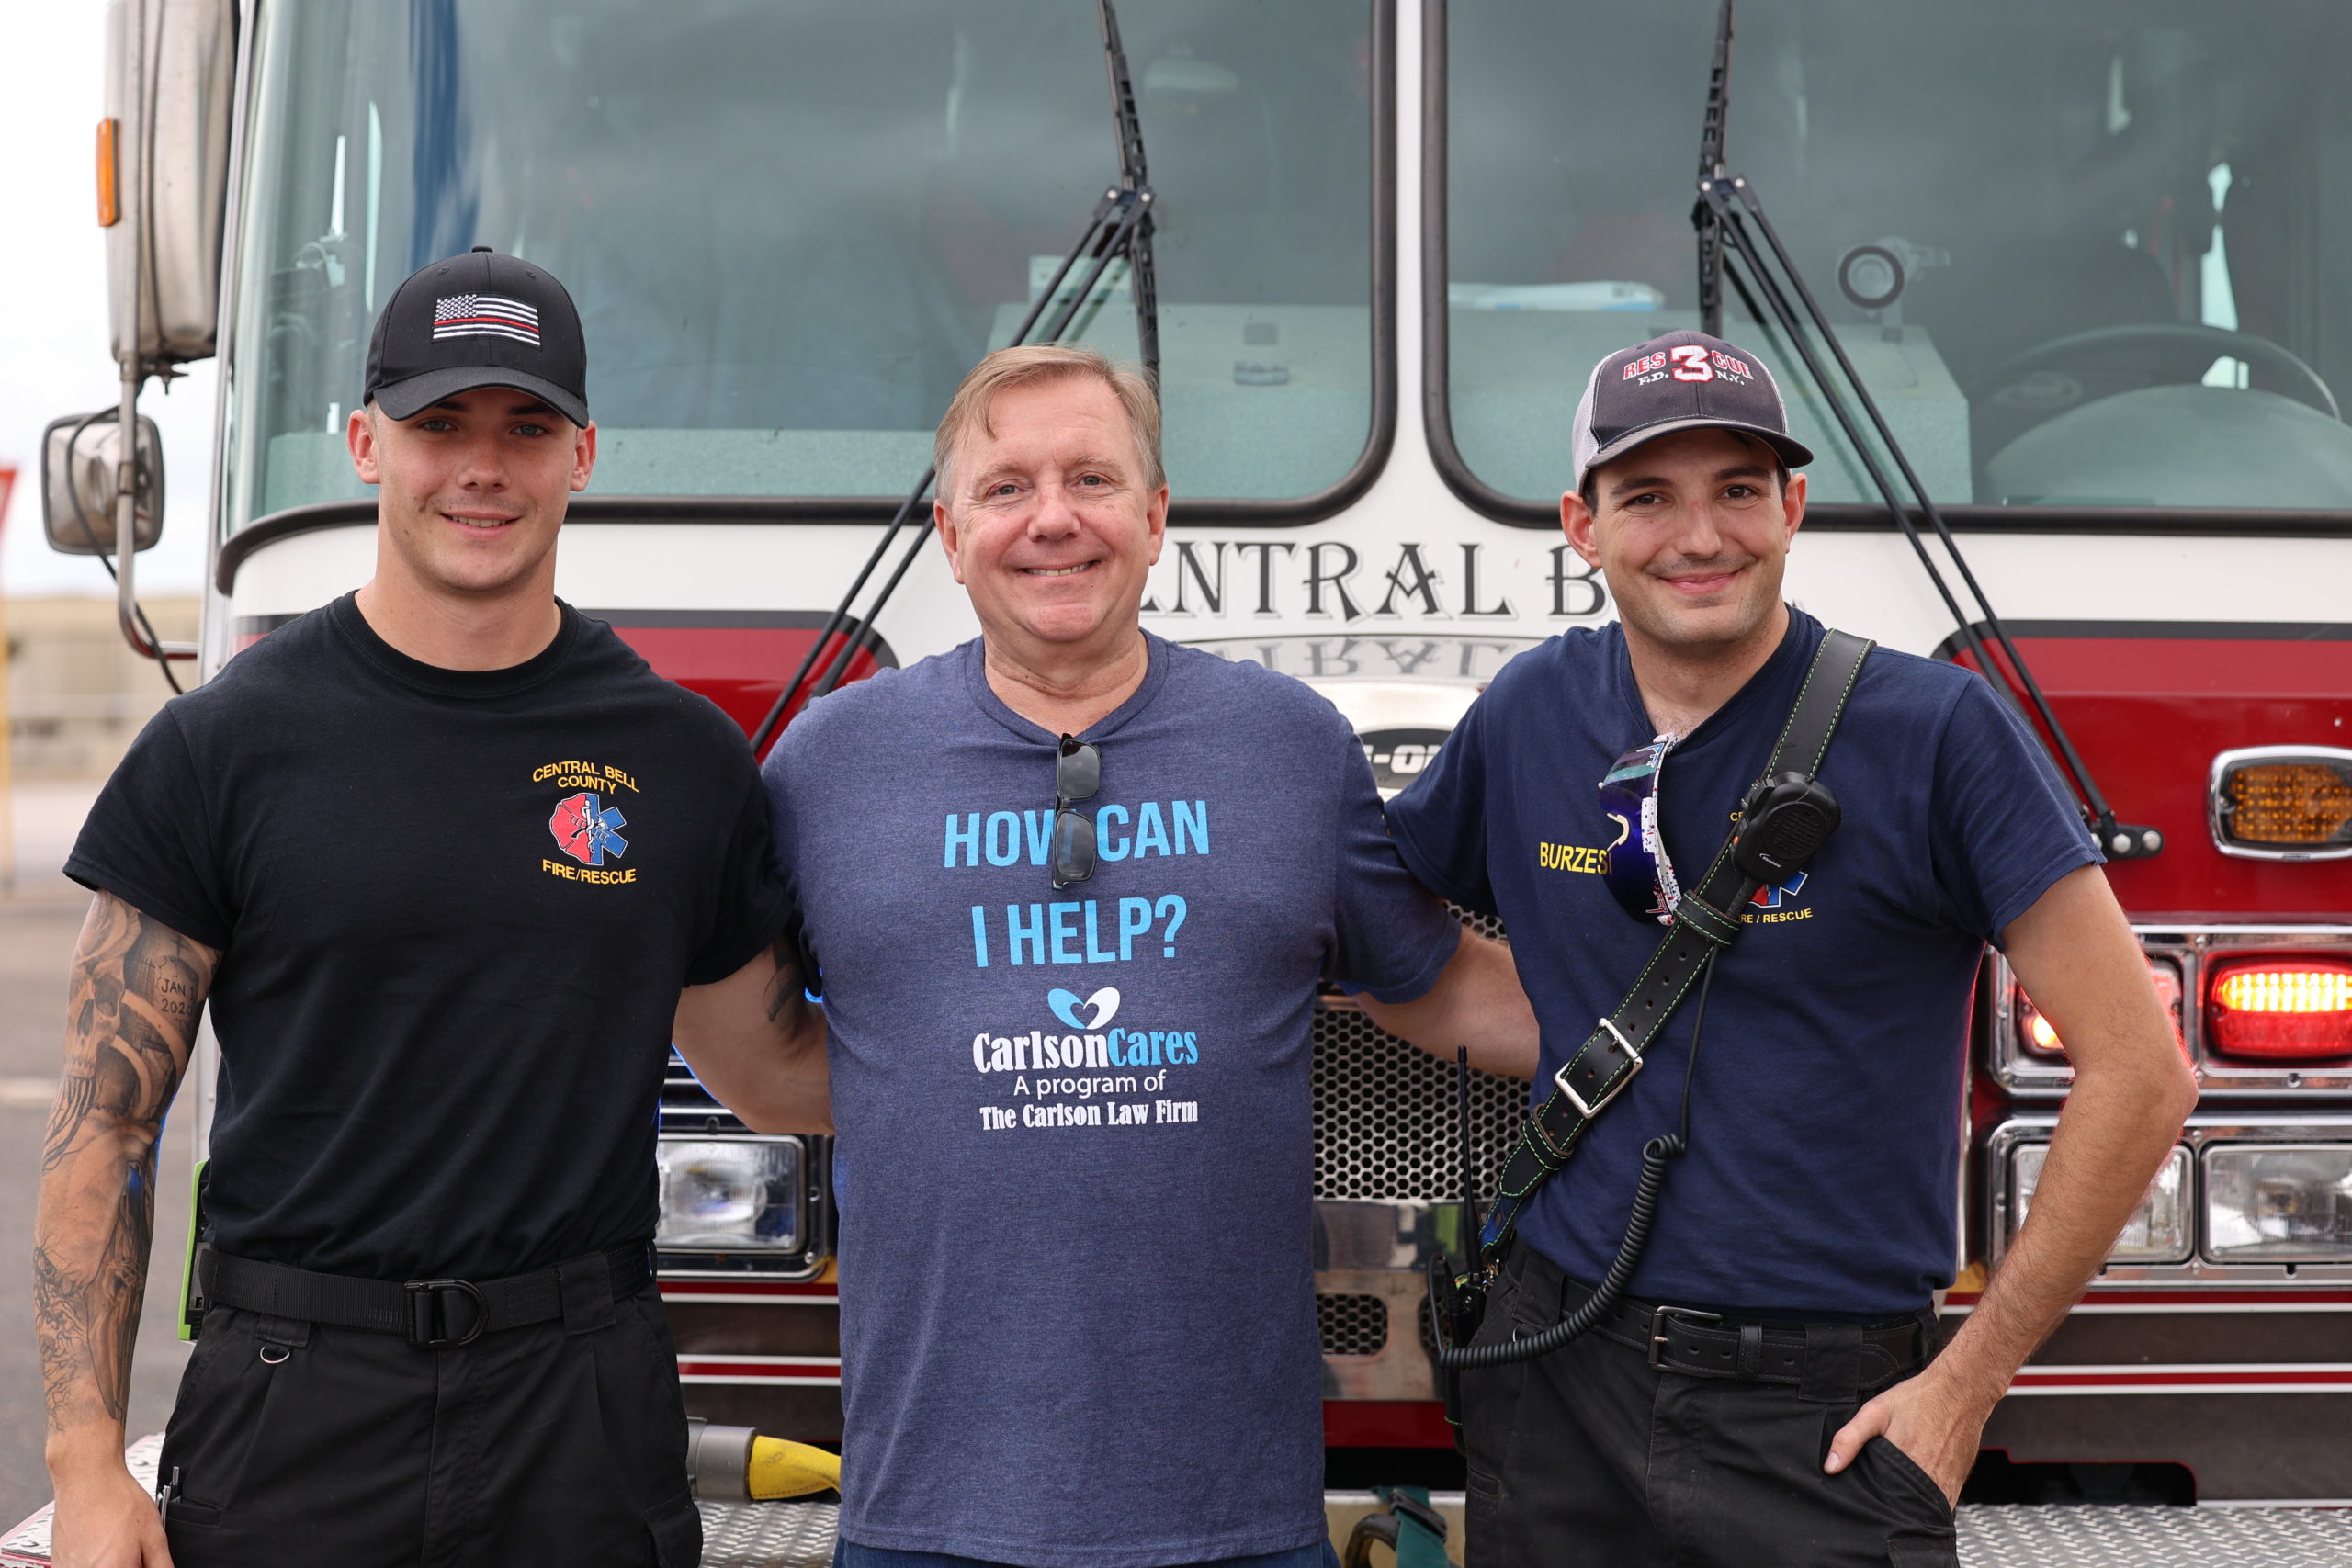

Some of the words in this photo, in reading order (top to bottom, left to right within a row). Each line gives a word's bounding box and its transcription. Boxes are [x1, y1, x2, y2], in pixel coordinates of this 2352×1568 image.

[1623, 352, 1667, 380] RES
[1669, 344, 1715, 383] 3
[1711, 350, 1754, 380] CUE
[1139, 541, 1512, 621] NTRAL
[533, 761, 600, 782] CENTRAL
[605, 765, 640, 794] BELL
[558, 775, 616, 794] COUNTY
[1096, 800, 1209, 862] CAN
[542, 859, 637, 885] FIRE/RESCUE
[971, 905, 989, 967] I
[1007, 894, 1187, 965] HELP?
[1740, 914, 1754, 924] RE
[1762, 908, 1814, 923] RESCUE
[973, 1027, 1198, 1074] CarlsonCares
[1013, 1075, 1030, 1096] A
[1036, 1076, 1137, 1100] program
[1144, 1069, 1167, 1091] of
[979, 1106, 1017, 1130] The
[1023, 1103, 1102, 1128] Carlson
[1107, 1101, 1149, 1125] Law
[1155, 1100, 1198, 1124] Firm
